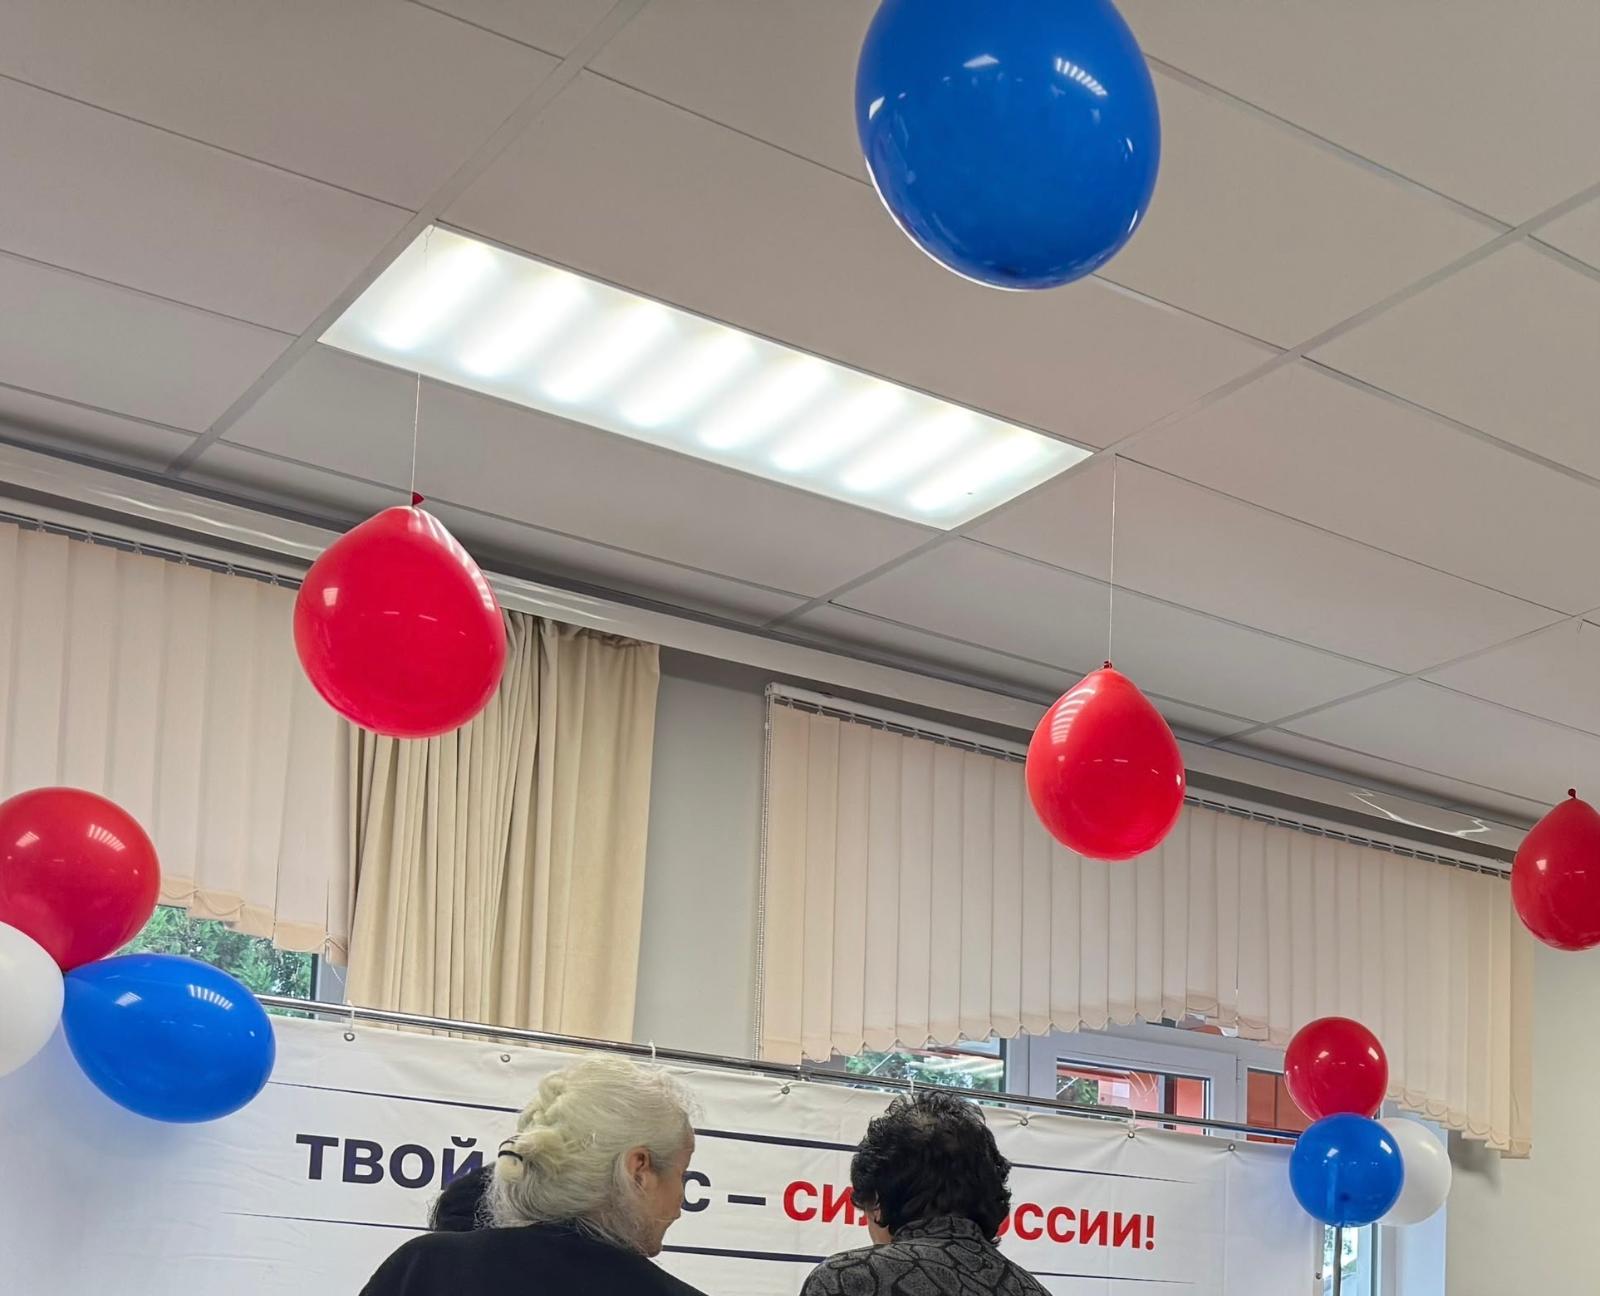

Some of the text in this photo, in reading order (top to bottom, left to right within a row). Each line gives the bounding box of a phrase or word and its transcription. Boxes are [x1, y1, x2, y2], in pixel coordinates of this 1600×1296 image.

[296, 1133, 484, 1191] ТВОЙ
[783, 1180, 869, 1226] СИ
[997, 1202, 1155, 1251] ССИИ!
